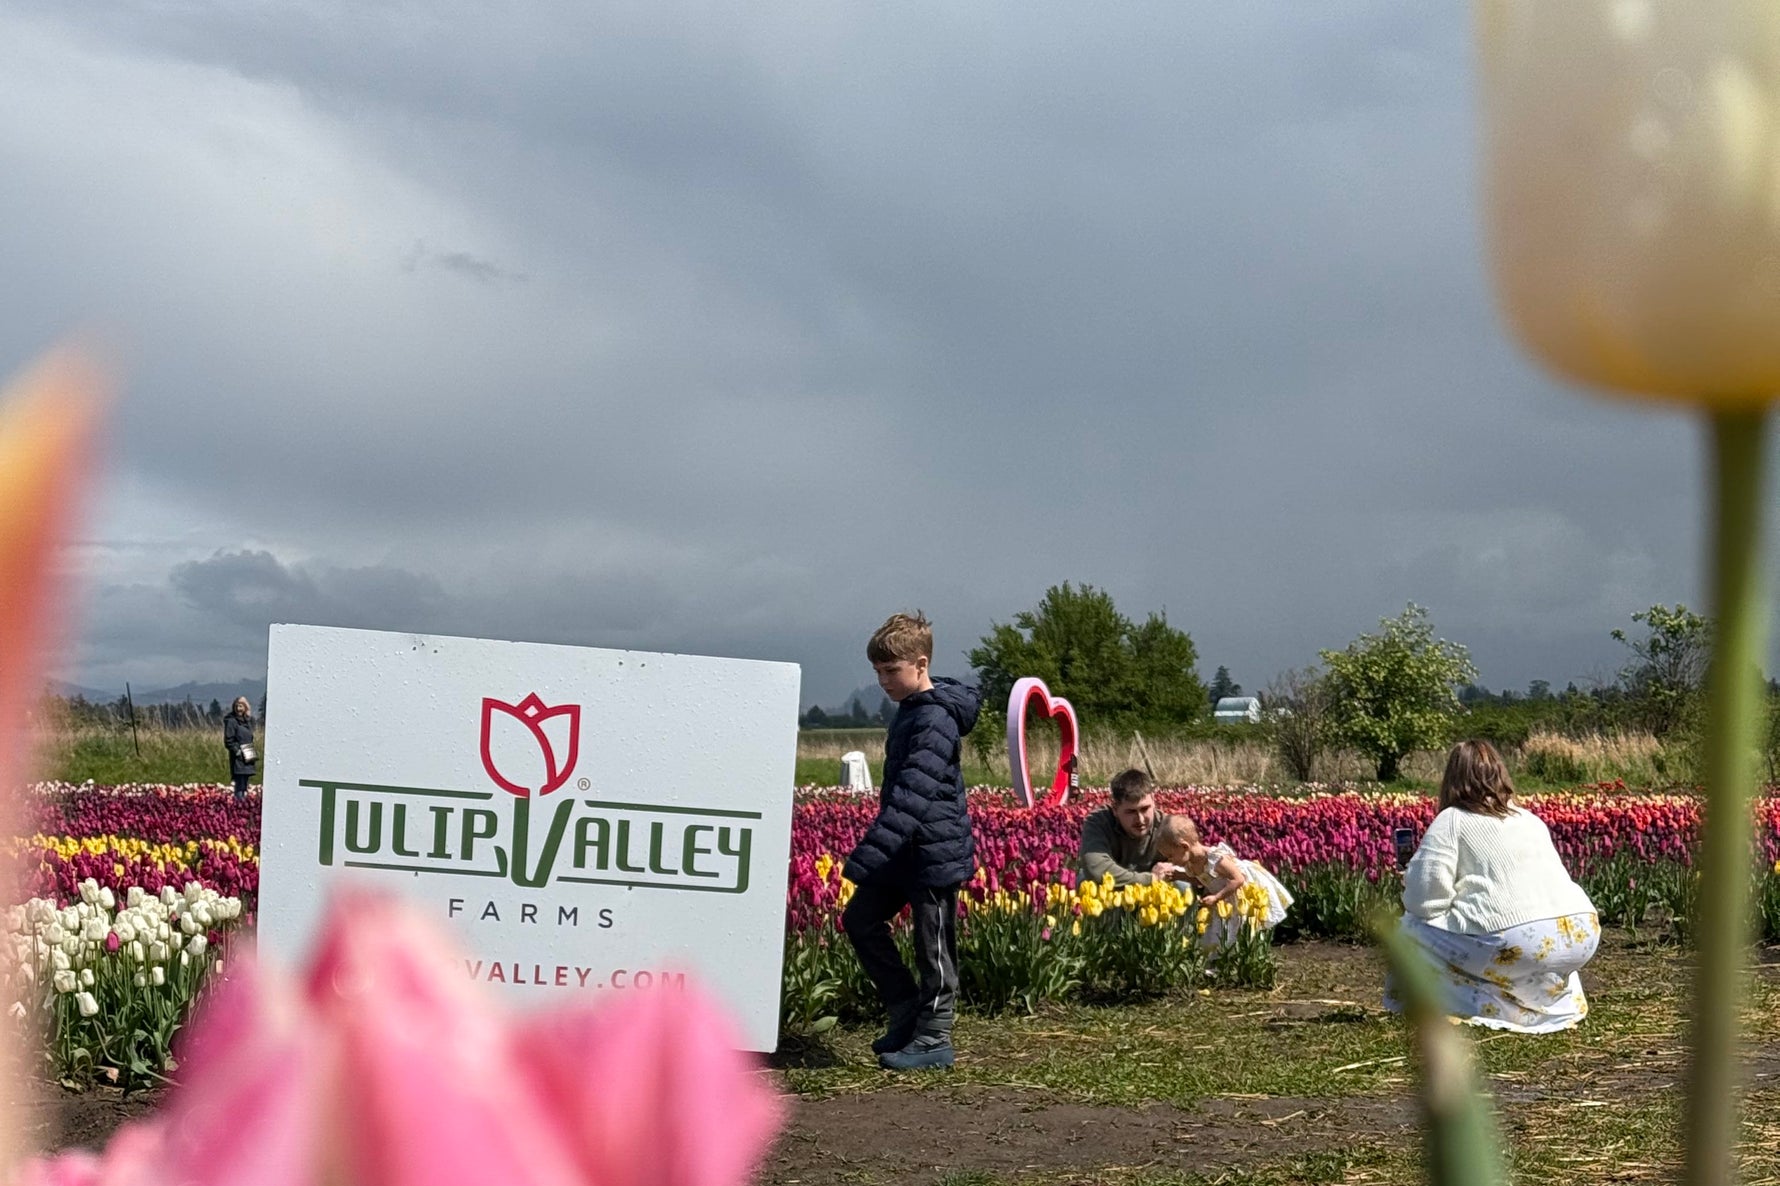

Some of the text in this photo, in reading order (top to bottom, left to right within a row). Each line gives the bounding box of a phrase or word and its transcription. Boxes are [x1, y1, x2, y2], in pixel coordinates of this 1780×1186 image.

[299, 779, 761, 894] TULIP VALLEY
[449, 898, 613, 929] FARMS
[453, 959, 686, 992] VALLEY.COM
